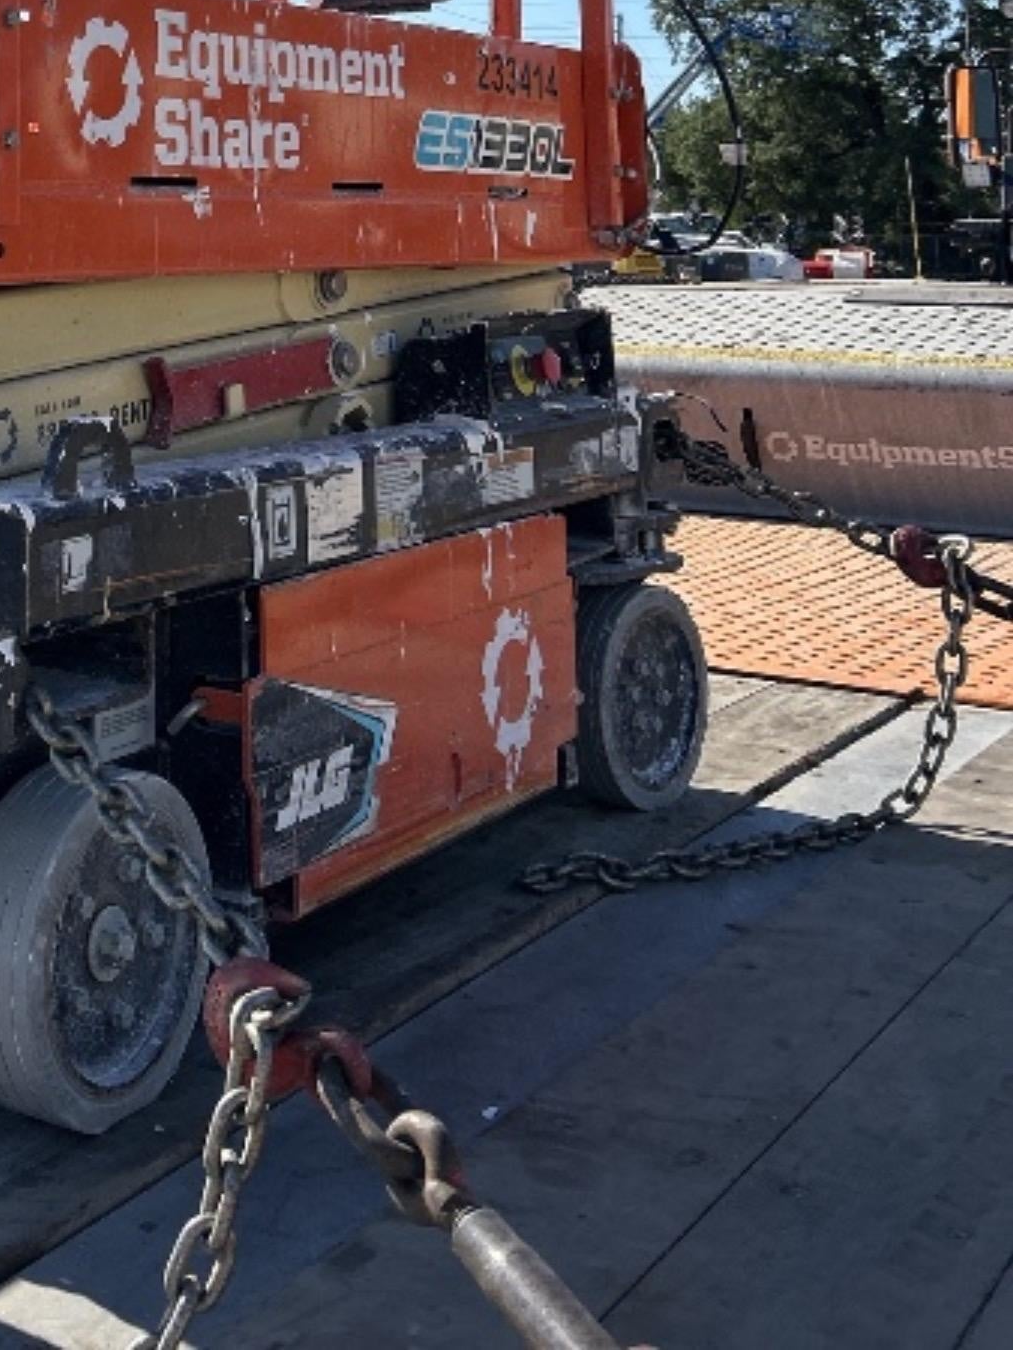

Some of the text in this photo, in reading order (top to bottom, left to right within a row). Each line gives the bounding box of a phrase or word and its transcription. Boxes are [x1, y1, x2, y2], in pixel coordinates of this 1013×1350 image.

[154, 9, 406, 103] Equipment
[478, 50, 558, 98] 233414
[154, 98, 301, 172] Share
[274, 743, 354, 832] JLG
